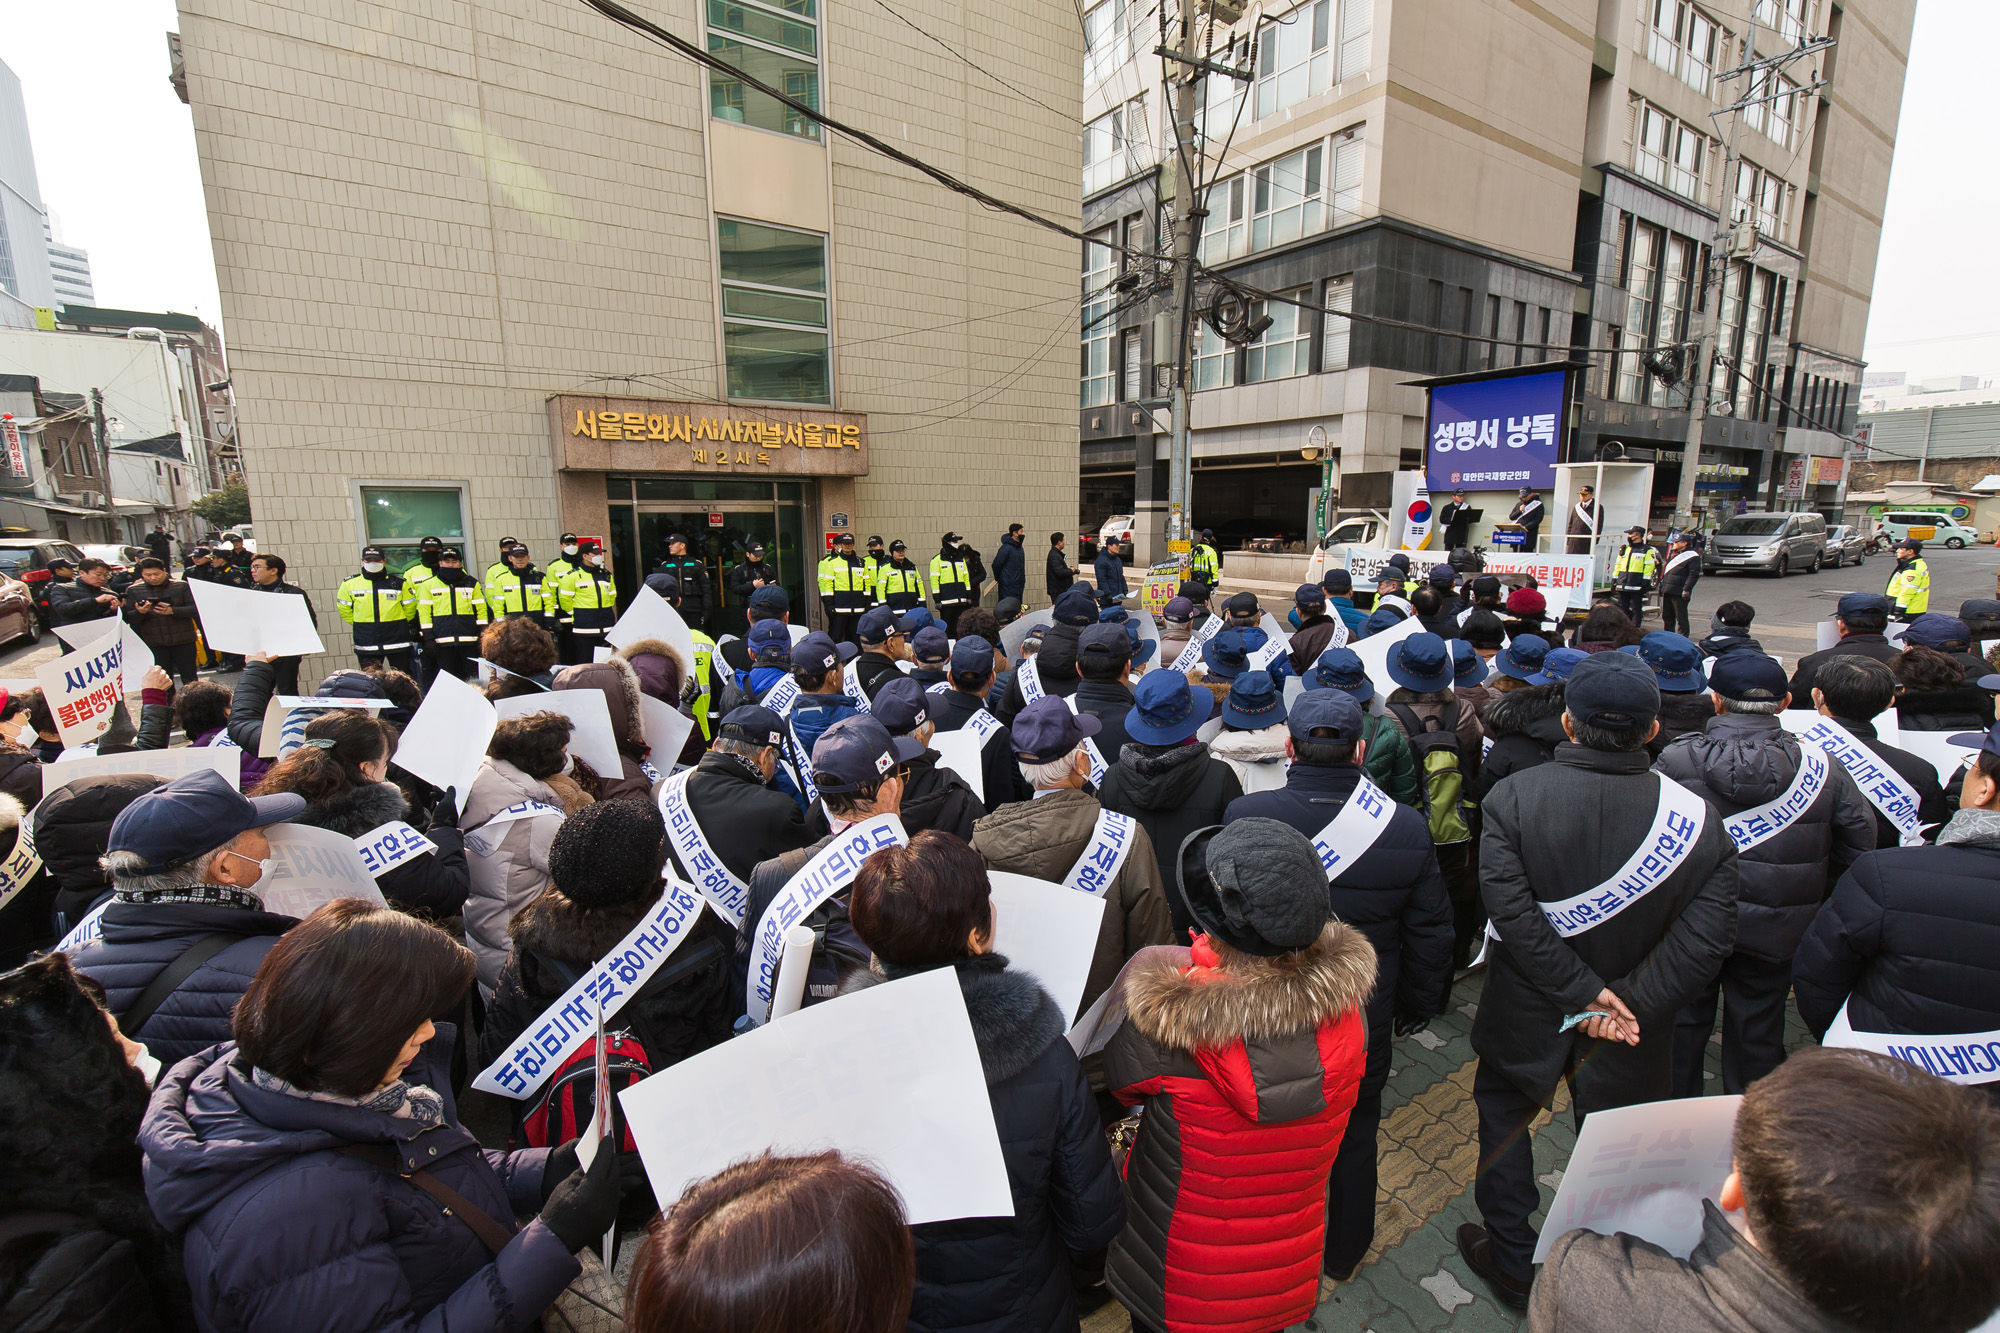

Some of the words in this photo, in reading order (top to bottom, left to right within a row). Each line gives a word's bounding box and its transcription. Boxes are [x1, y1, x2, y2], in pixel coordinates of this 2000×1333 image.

[1433, 418, 1499, 453] 성명서
[1506, 413, 1555, 449] 낭독
[1463, 470, 1530, 482] 대한민국재향군인회
[1789, 461, 1803, 489] 부동산
[1351, 557, 1366, 576] 향군
[1552, 565, 1585, 588] 맞나?
[57, 682, 119, 729] 불법행위
